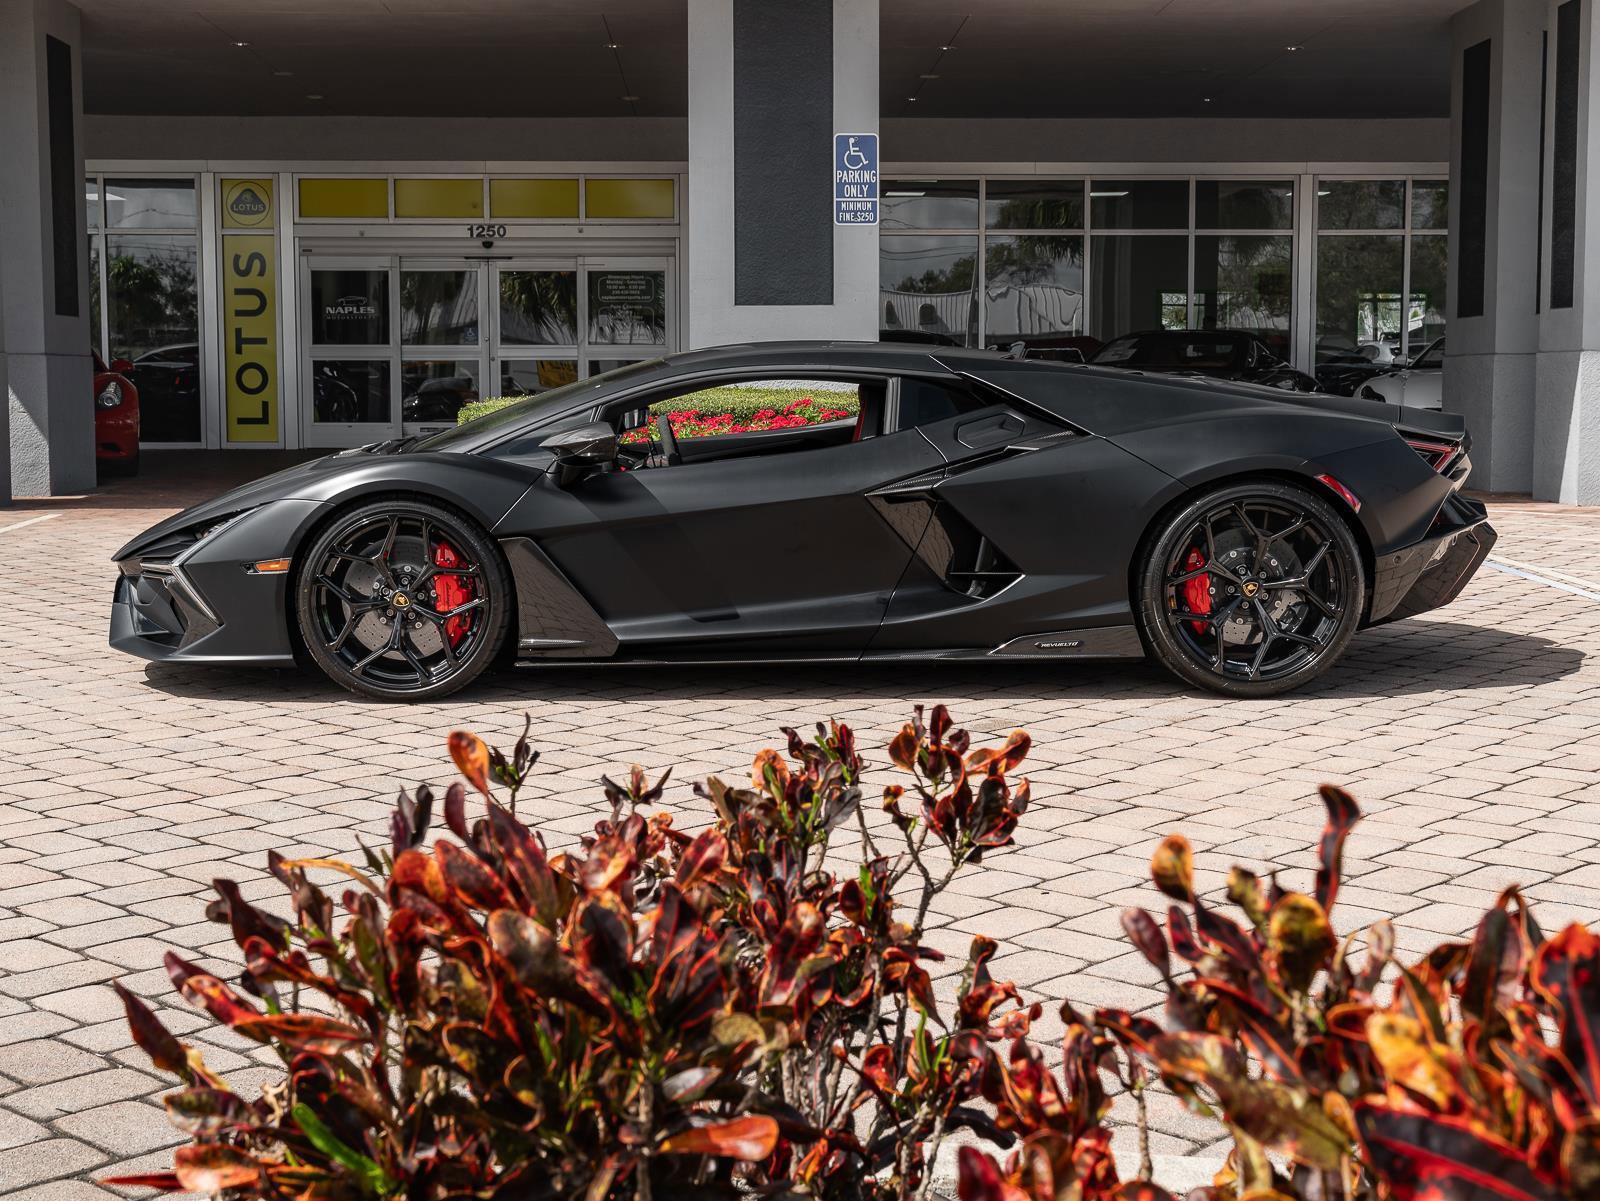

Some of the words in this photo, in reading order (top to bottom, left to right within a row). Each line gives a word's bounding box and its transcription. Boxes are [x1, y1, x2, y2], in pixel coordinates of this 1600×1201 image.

[836, 170, 876, 183] PARKING
[844, 184, 869, 197] ONLY
[233, 203, 264, 211] LOTUS
[841, 201, 872, 211] MINIMUM
[839, 212, 854, 222] FINE
[467, 224, 507, 238] 1250
[325, 306, 376, 314] NAPLES
[232, 251, 269, 425] LOTUS
